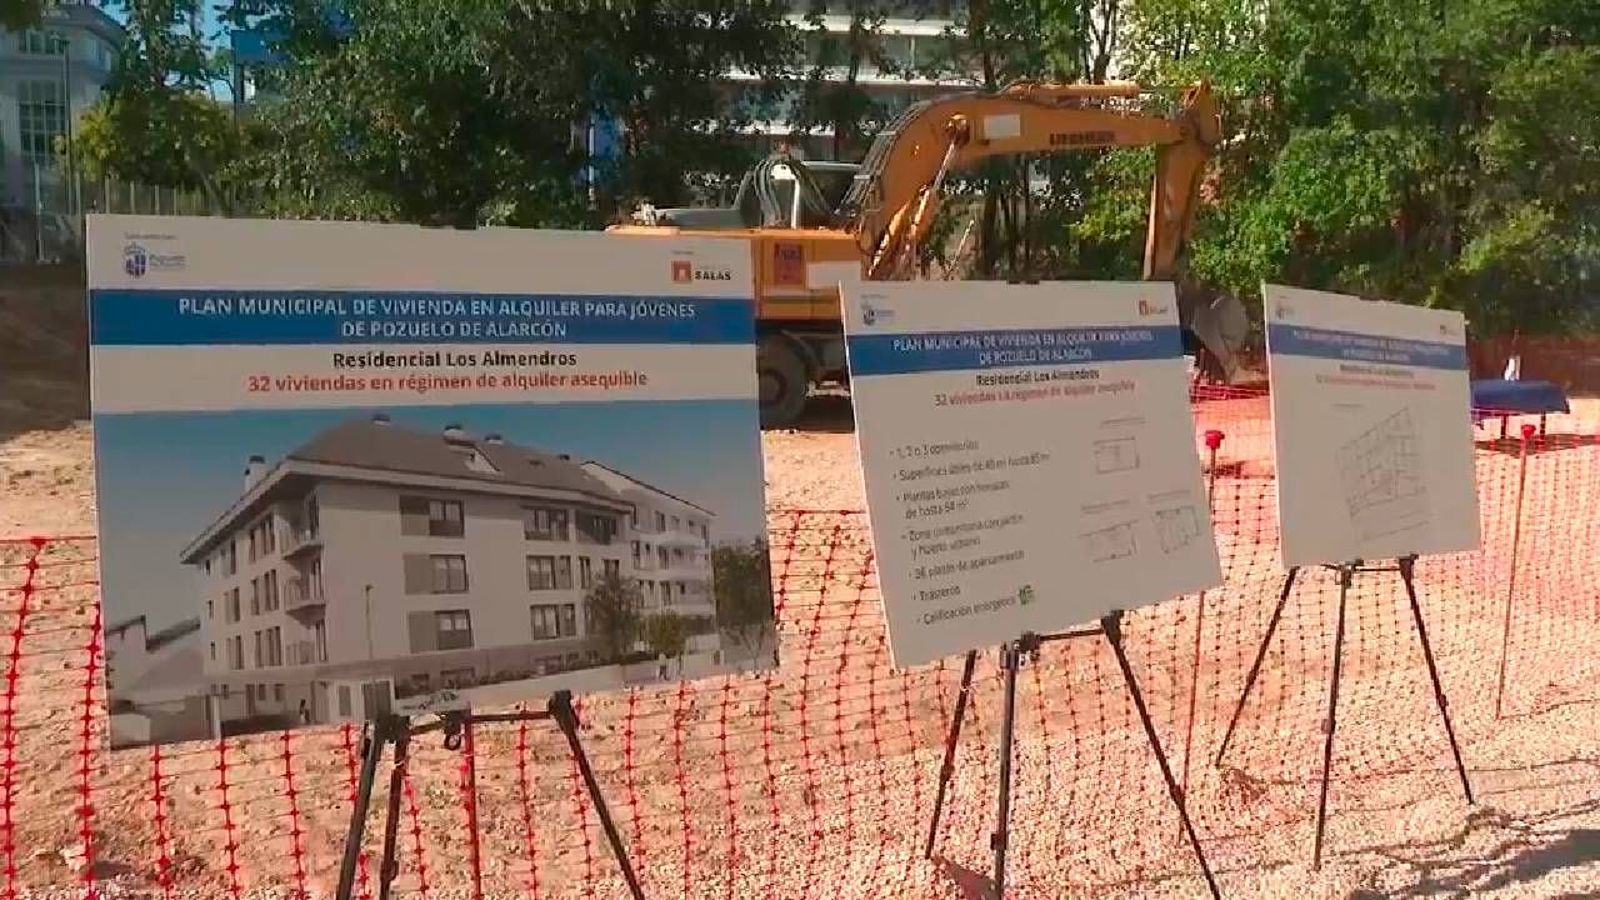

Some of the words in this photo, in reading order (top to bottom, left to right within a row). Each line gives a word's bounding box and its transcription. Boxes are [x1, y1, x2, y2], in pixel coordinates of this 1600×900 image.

[694, 270, 732, 281] SALAS
[178, 298, 232, 315] PLAN
[239, 299, 347, 316] MUNICIPAL
[353, 299, 377, 315] DE
[381, 299, 466, 317] VIVIENDA
[470, 300, 496, 316] EN
[499, 300, 580, 319] ALQUILER
[584, 302, 627, 318] PARA
[630, 300, 696, 321] JÓVENES
[341, 321, 365, 337] DE
[371, 321, 455, 338] POZUELO
[459, 322, 482, 338] DE
[485, 319, 567, 338] ALARCÓN
[333, 352, 441, 369] Residencial
[446, 352, 477, 368] Los
[482, 350, 577, 367] Almendros
[248, 376, 272, 392] 32
[275, 374, 366, 391] viviendas
[371, 377, 392, 390] en
[399, 374, 472, 394] régimen
[476, 373, 496, 388] de
[501, 371, 566, 391] alquiler
[571, 370, 648, 391] asequible
